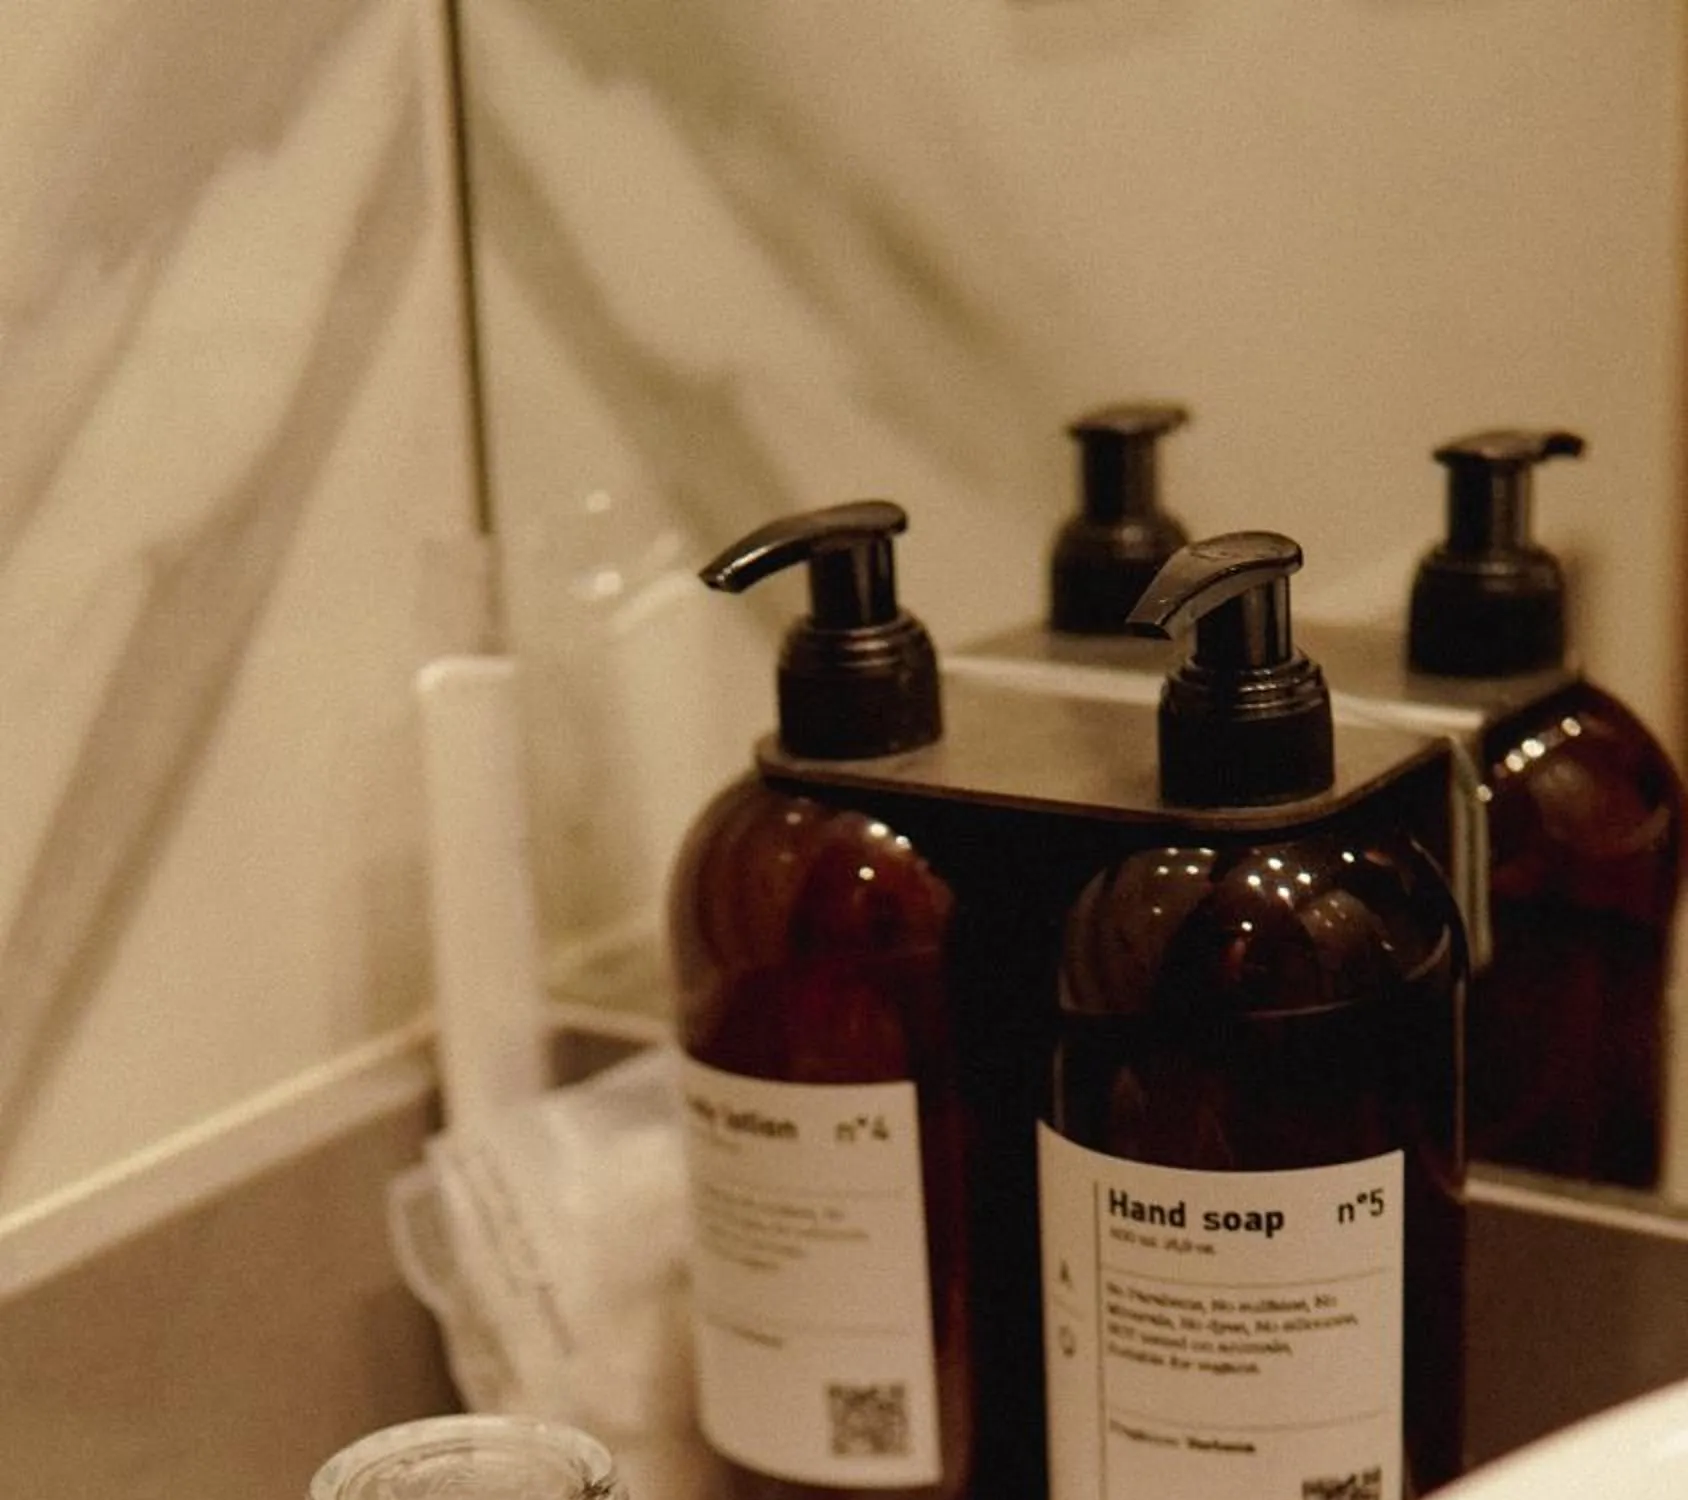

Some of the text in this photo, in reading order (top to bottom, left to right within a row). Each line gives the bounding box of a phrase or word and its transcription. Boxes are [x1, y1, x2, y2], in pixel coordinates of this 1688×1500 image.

[1108, 1187, 1284, 1239] Hand soap
[1337, 1188, 1385, 1225] n°5
